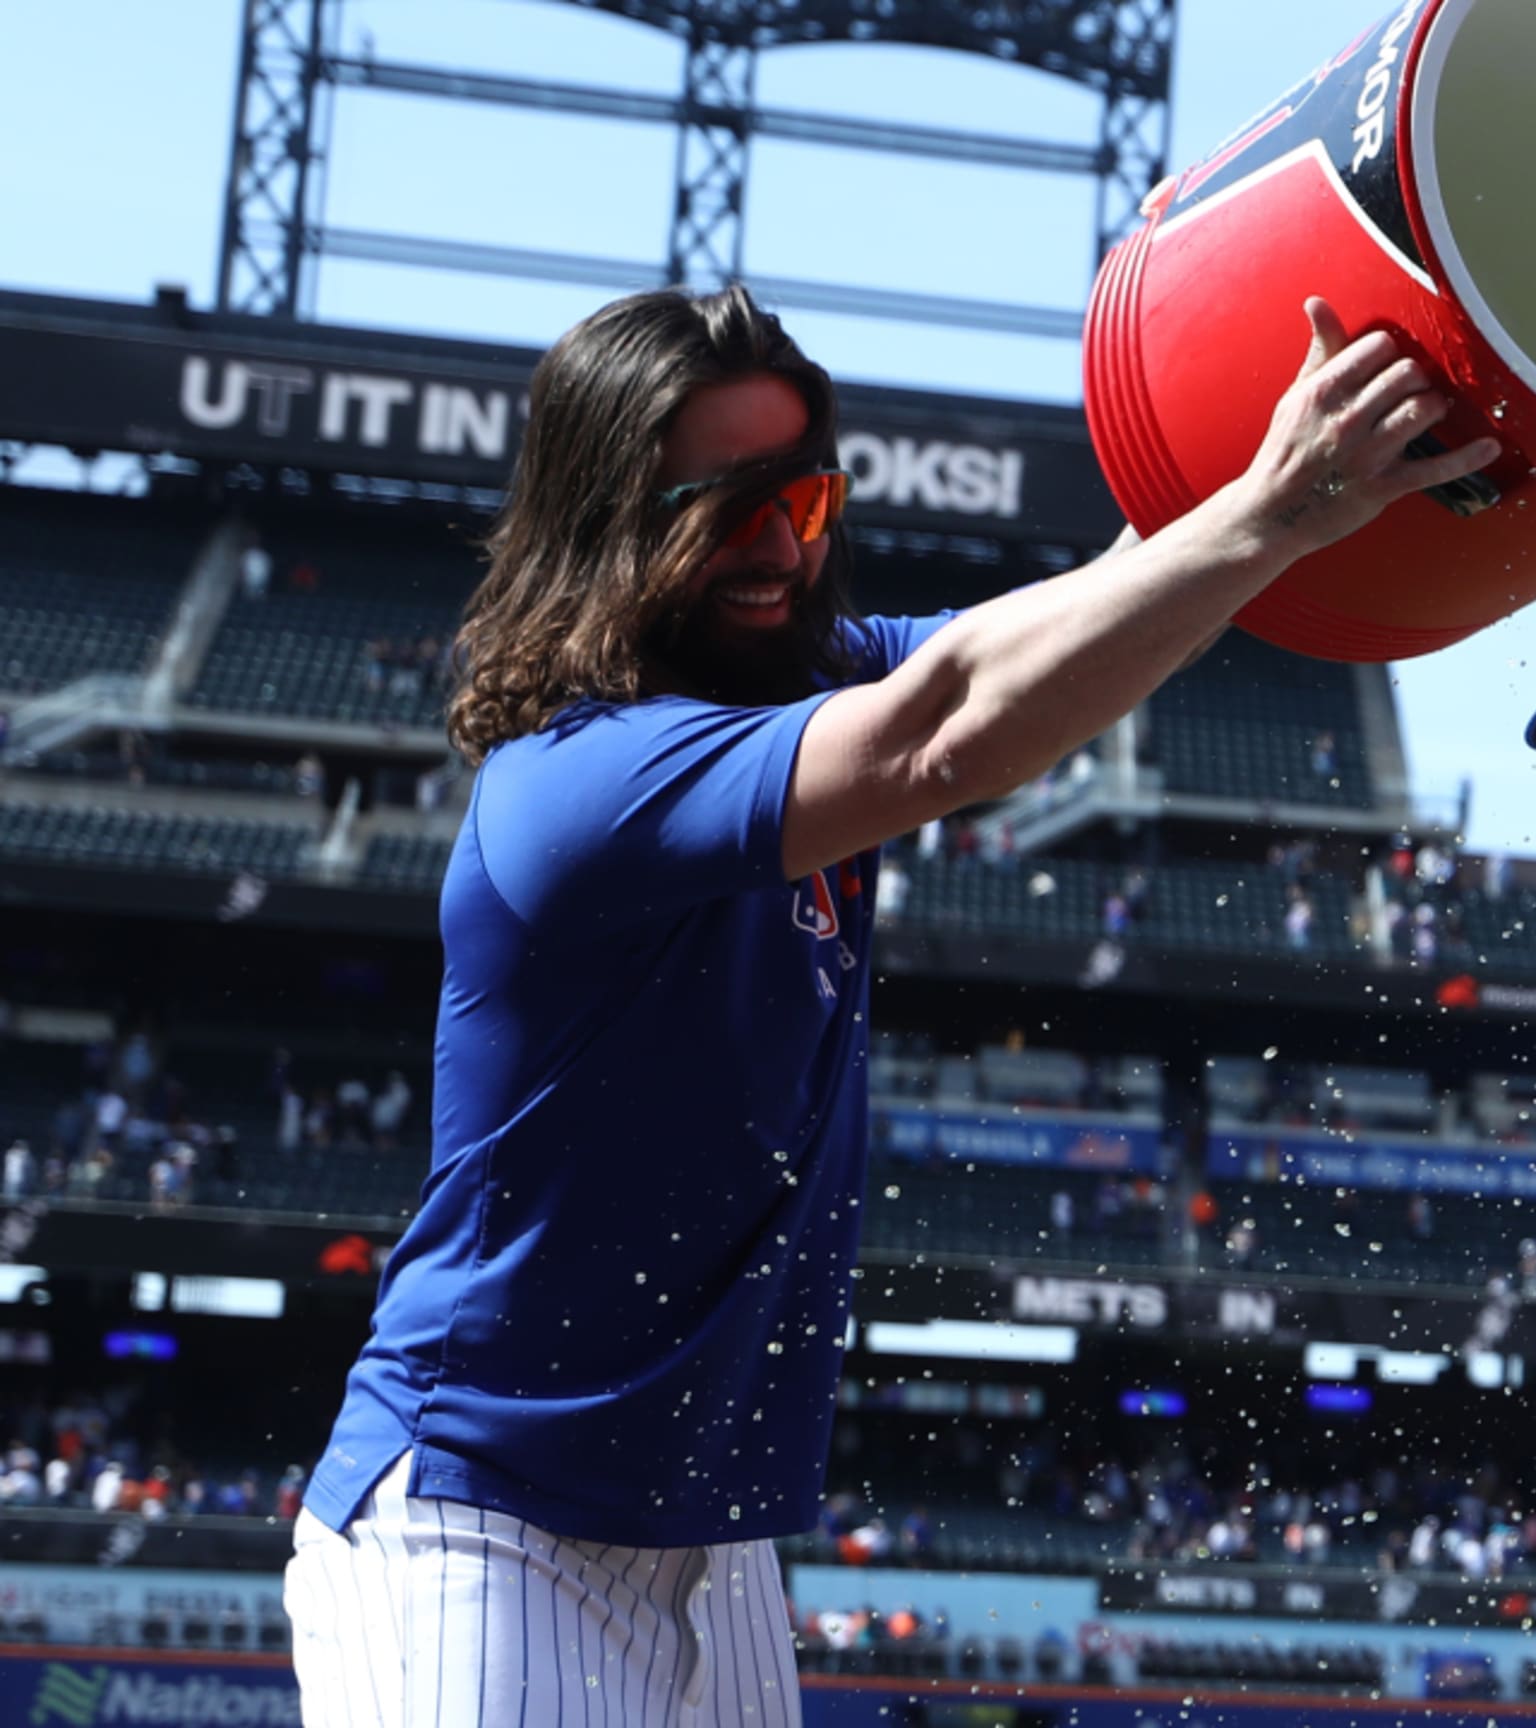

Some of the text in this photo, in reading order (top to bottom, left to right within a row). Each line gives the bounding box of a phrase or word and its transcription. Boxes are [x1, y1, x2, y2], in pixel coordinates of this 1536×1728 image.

[319, 373, 412, 448] IT
[418, 381, 508, 460] IN
[838, 431, 1024, 518] OKS!
[1012, 1275, 1276, 1335] METS IN
